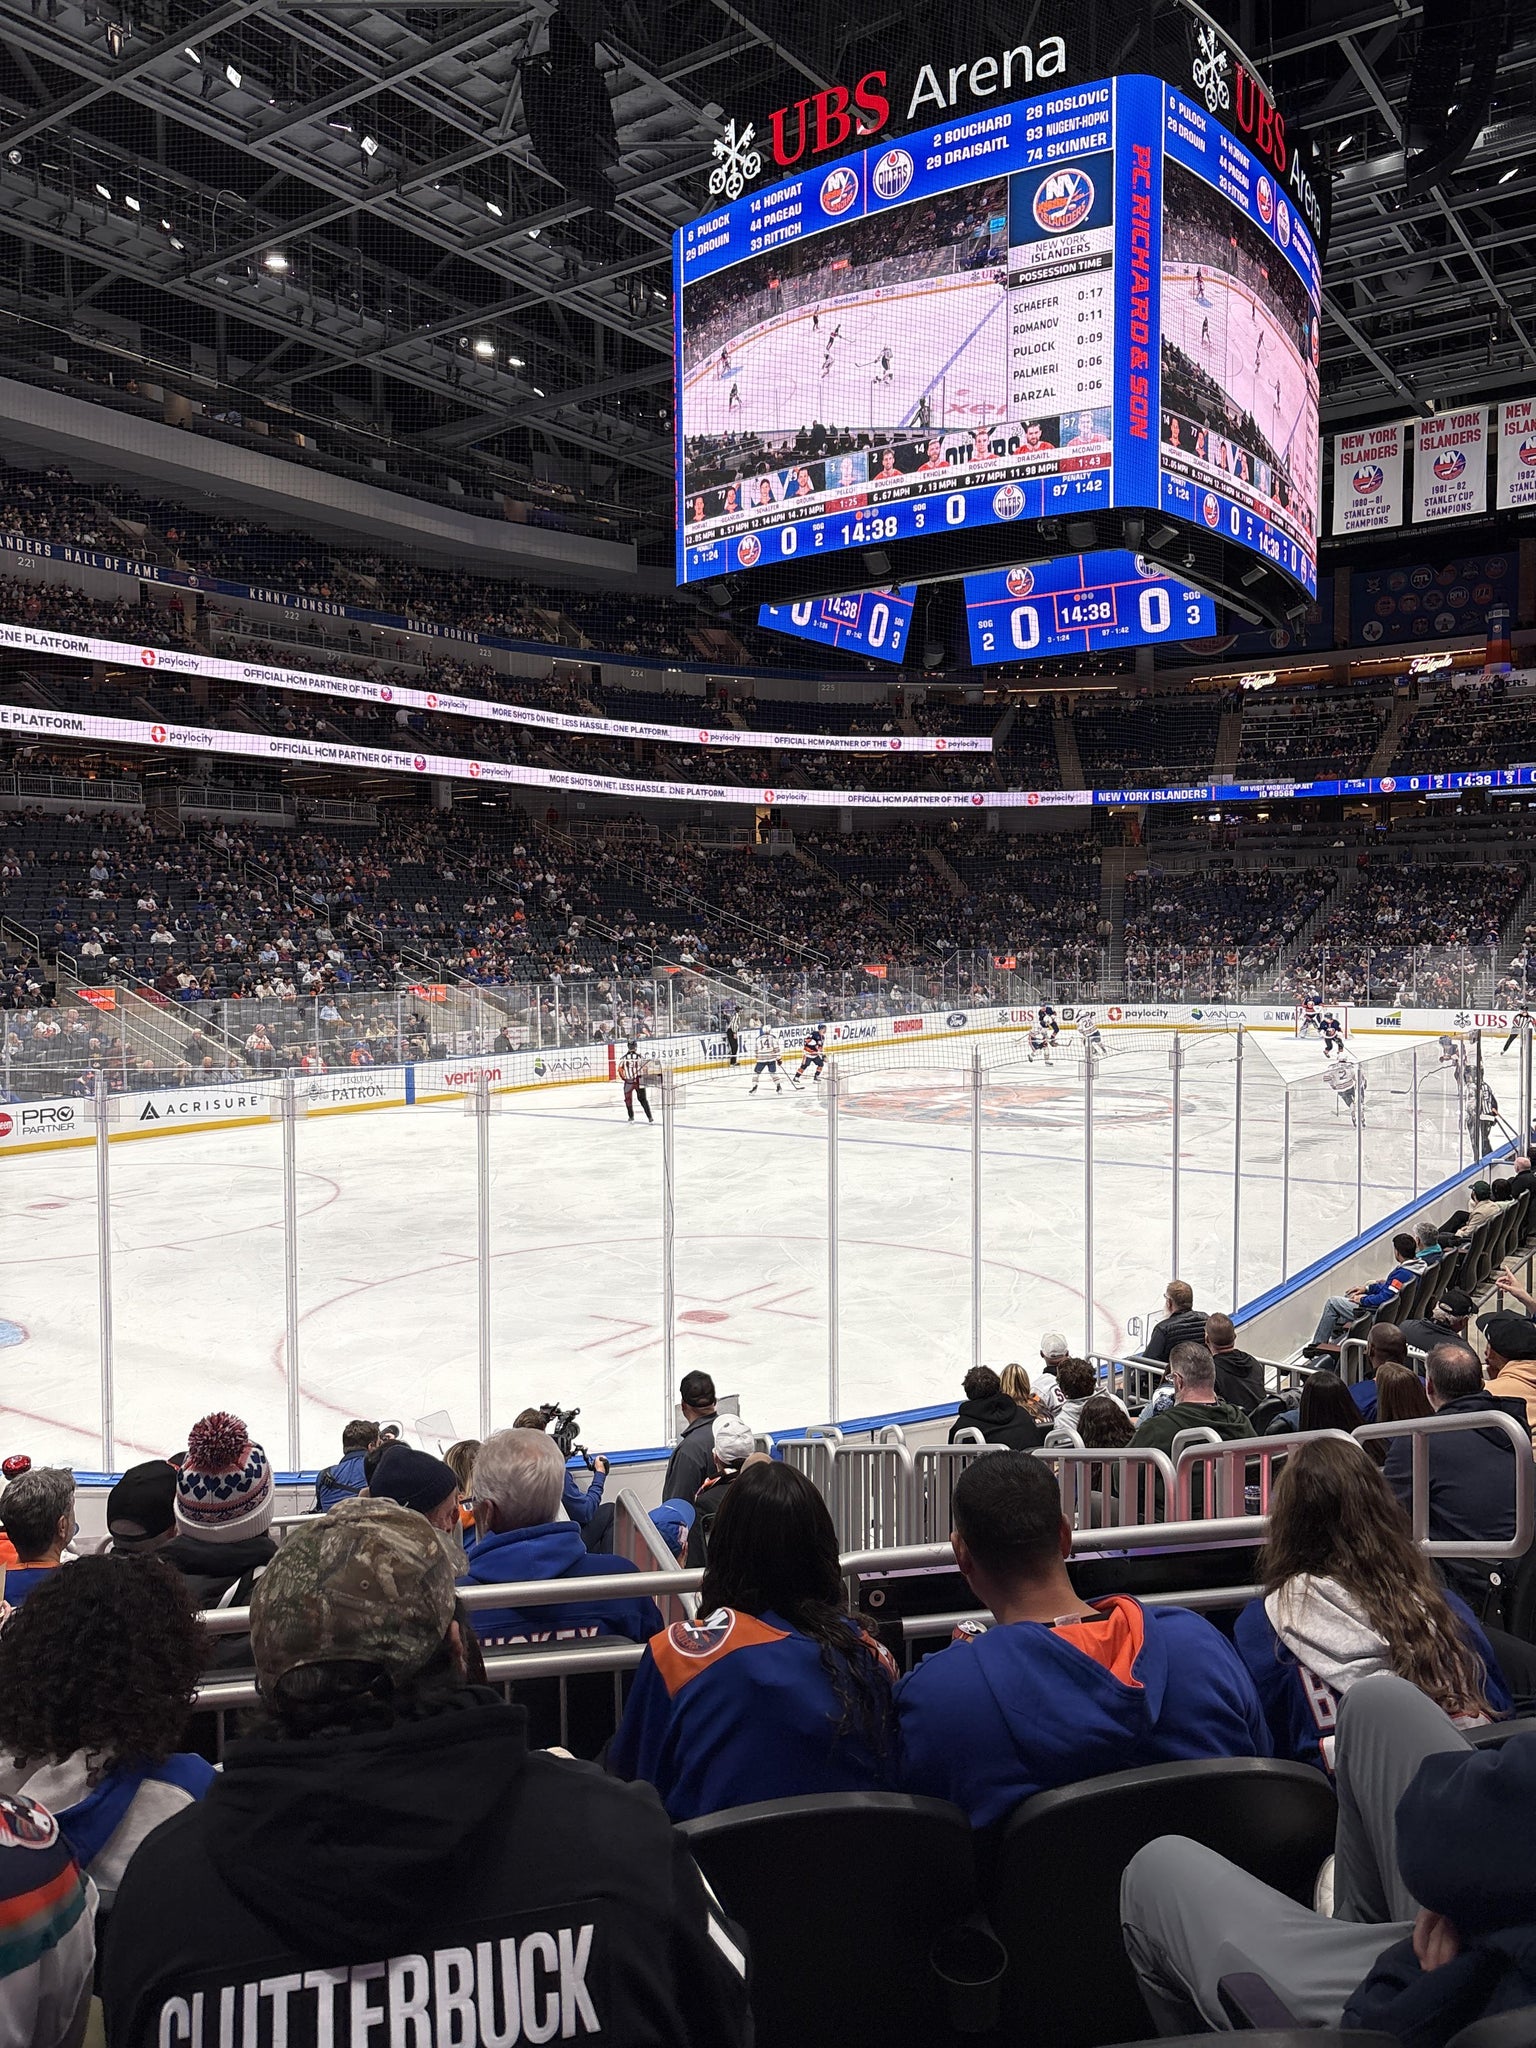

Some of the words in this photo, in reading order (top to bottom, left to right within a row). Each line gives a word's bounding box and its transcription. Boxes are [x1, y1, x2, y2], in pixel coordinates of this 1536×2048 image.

[768, 71, 890, 165] UBS
[907, 36, 1066, 120] Arena
[1026, 106, 1043, 121] 28
[1046, 88, 1108, 115] ROSLOVIC
[934, 133, 942, 148] 2
[944, 114, 1012, 144] BOUCHARD
[1026, 127, 1043, 142] 93
[1046, 110, 1108, 137] NUGENT-HOPKI
[926, 156, 942, 170] 29
[944, 136, 1010, 164] DRAISAITL
[1026, 148, 1043, 163] 74
[1046, 132, 1106, 158] SKINNER
[1235, 62, 1285, 172] UBS
[1290, 148, 1320, 238] Arena
[764, 182, 802, 208] HORVAT
[764, 202, 802, 227] PAGEAU
[698, 213, 730, 238] PULOCK
[764, 222, 801, 246] RITTICH
[686, 248, 696, 262] 29
[698, 232, 730, 256] DROUIN
[1036, 240, 1058, 252] NEW
[1061, 234, 1086, 247] YORK
[1032, 242, 1090, 264] ISLANDERS
[1019, 261, 1076, 283] POSSESSION
[1080, 258, 1102, 270] TIME
[1130, 193, 1151, 345] RICHARD
[1014, 296, 1059, 314] SCHAEFER
[1078, 288, 1103, 300] 0:17
[1014, 318, 1059, 335] ROMANOV
[1078, 310, 1102, 322] 0:11
[1014, 341, 1055, 357] PULOCK
[1078, 332, 1102, 344] 0:09
[1130, 346, 1148, 370] &
[1014, 364, 1058, 380] PALMIERI
[1078, 356, 1102, 368] 0:06
[1014, 388, 1056, 403] BARZAL
[1078, 380, 1102, 392] 0:06
[1130, 374, 1148, 439] SON
[1506, 402, 1532, 419] NEW
[1421, 419, 1446, 435] NEW
[1450, 412, 1480, 430] YORK
[1342, 435, 1364, 450] NEW
[1369, 428, 1398, 445] YORK
[1420, 429, 1481, 450] ISLANDERS
[1072, 444, 1102, 455] MCDAVID
[1340, 444, 1398, 466] ISLANDERS
[969, 460, 997, 471] ROSLOVIC
[1010, 466, 1036, 478] 11.98
[1038, 462, 1058, 474] MPH
[965, 474, 986, 485] 8.77
[987, 469, 1006, 481] MPH
[1053, 484, 1068, 496] 97
[1075, 480, 1102, 494] 1:42
[913, 503, 926, 512] SOG
[1424, 494, 1456, 507] STANLEY
[1456, 490, 1474, 502] CUP
[946, 494, 966, 524] 0
[1344, 507, 1376, 520] STANLEY
[1376, 504, 1390, 515] CUP
[1426, 502, 1472, 518] CHAMPIONS
[916, 514, 925, 528] 3
[1346, 516, 1389, 530] CHAMPIONS
[815, 533, 824, 546] 2
[842, 516, 898, 546] 14:38
[781, 527, 798, 555] 0
[17, 556, 36, 568] 221
[64, 548, 98, 567] HALL
[105, 558, 120, 571] OF
[126, 561, 160, 580] FAME
[250, 588, 288, 606] KENNY
[294, 598, 346, 617] JONSSON
[1139, 587, 1171, 634] 0
[284, 610, 300, 621] 222
[1061, 602, 1111, 624] 14:38
[1186, 605, 1200, 624] 3
[408, 620, 439, 636] BUTCH
[444, 626, 480, 644] GORING
[868, 603, 889, 648] 0
[978, 619, 994, 629] SOG
[1010, 605, 1040, 650] 0
[25, 633, 92, 654] PLATFORM.
[982, 632, 995, 651] 2
[158, 654, 200, 670] paylocity
[1410, 654, 1453, 675] Tailgate
[244, 668, 286, 682] OFFICIAL
[286, 674, 308, 686] HCM
[309, 678, 348, 692] PARTNER
[350, 684, 360, 694] OF
[360, 686, 378, 697] THE
[822, 684, 835, 692] 225
[438, 700, 468, 712] paylocity
[13, 714, 86, 732] PLATFORM.
[492, 706, 512, 718] MORE
[512, 710, 535, 722] SHOTS
[562, 718, 578, 728] LESS
[170, 731, 214, 746] paylocity
[710, 733, 742, 743] paylocity
[774, 736, 806, 746] OFFICIAL
[808, 738, 824, 746] HCM
[826, 739, 860, 747] PARTNER
[948, 740, 978, 748] paylocity
[270, 742, 314, 755] OFFICIAL
[314, 747, 337, 758] HCM
[338, 750, 380, 763] PARTNER
[381, 754, 394, 764] OF
[394, 756, 412, 766] THE
[481, 766, 512, 778] paylocity
[550, 774, 570, 784] MORE
[570, 776, 592, 787] SHOTS
[618, 782, 634, 792] LESS
[1250, 784, 1266, 792] VISIT
[1410, 778, 1420, 789] 0
[1457, 776, 1492, 787] 14:38
[848, 795, 882, 803] OFFICIAL
[882, 795, 902, 803] HCM
[902, 796, 940, 804] PARTNER
[1040, 794, 1074, 802] paylocity
[1098, 792, 1122, 802] NEW
[1123, 790, 1149, 801] YORK
[1151, 788, 1208, 800] ISLANDERS
[949, 1014, 966, 1026] Ford
[1010, 1010, 1034, 1022] UBS
[1125, 1009, 1168, 1020] paylocity
[1204, 1009, 1247, 1020] VANDA
[1276, 1011, 1291, 1021] NEW
[1376, 1016, 1402, 1026] DIME
[1474, 1014, 1508, 1028] UBS
[779, 1028, 816, 1038] AMERICAN
[842, 1024, 877, 1040] DELMAR
[894, 1018, 924, 1033] BENIHANA
[700, 1035, 748, 1060] Vank
[760, 1038, 770, 1048] 14
[642, 1047, 686, 1060] CRISURE
[548, 1056, 591, 1072] VANDA
[342, 1075, 374, 1085] TEQUILA
[166, 1096, 258, 1115] ACRISURE
[22, 1106, 74, 1126] PRO
[22, 1122, 75, 1135] PARTNER
